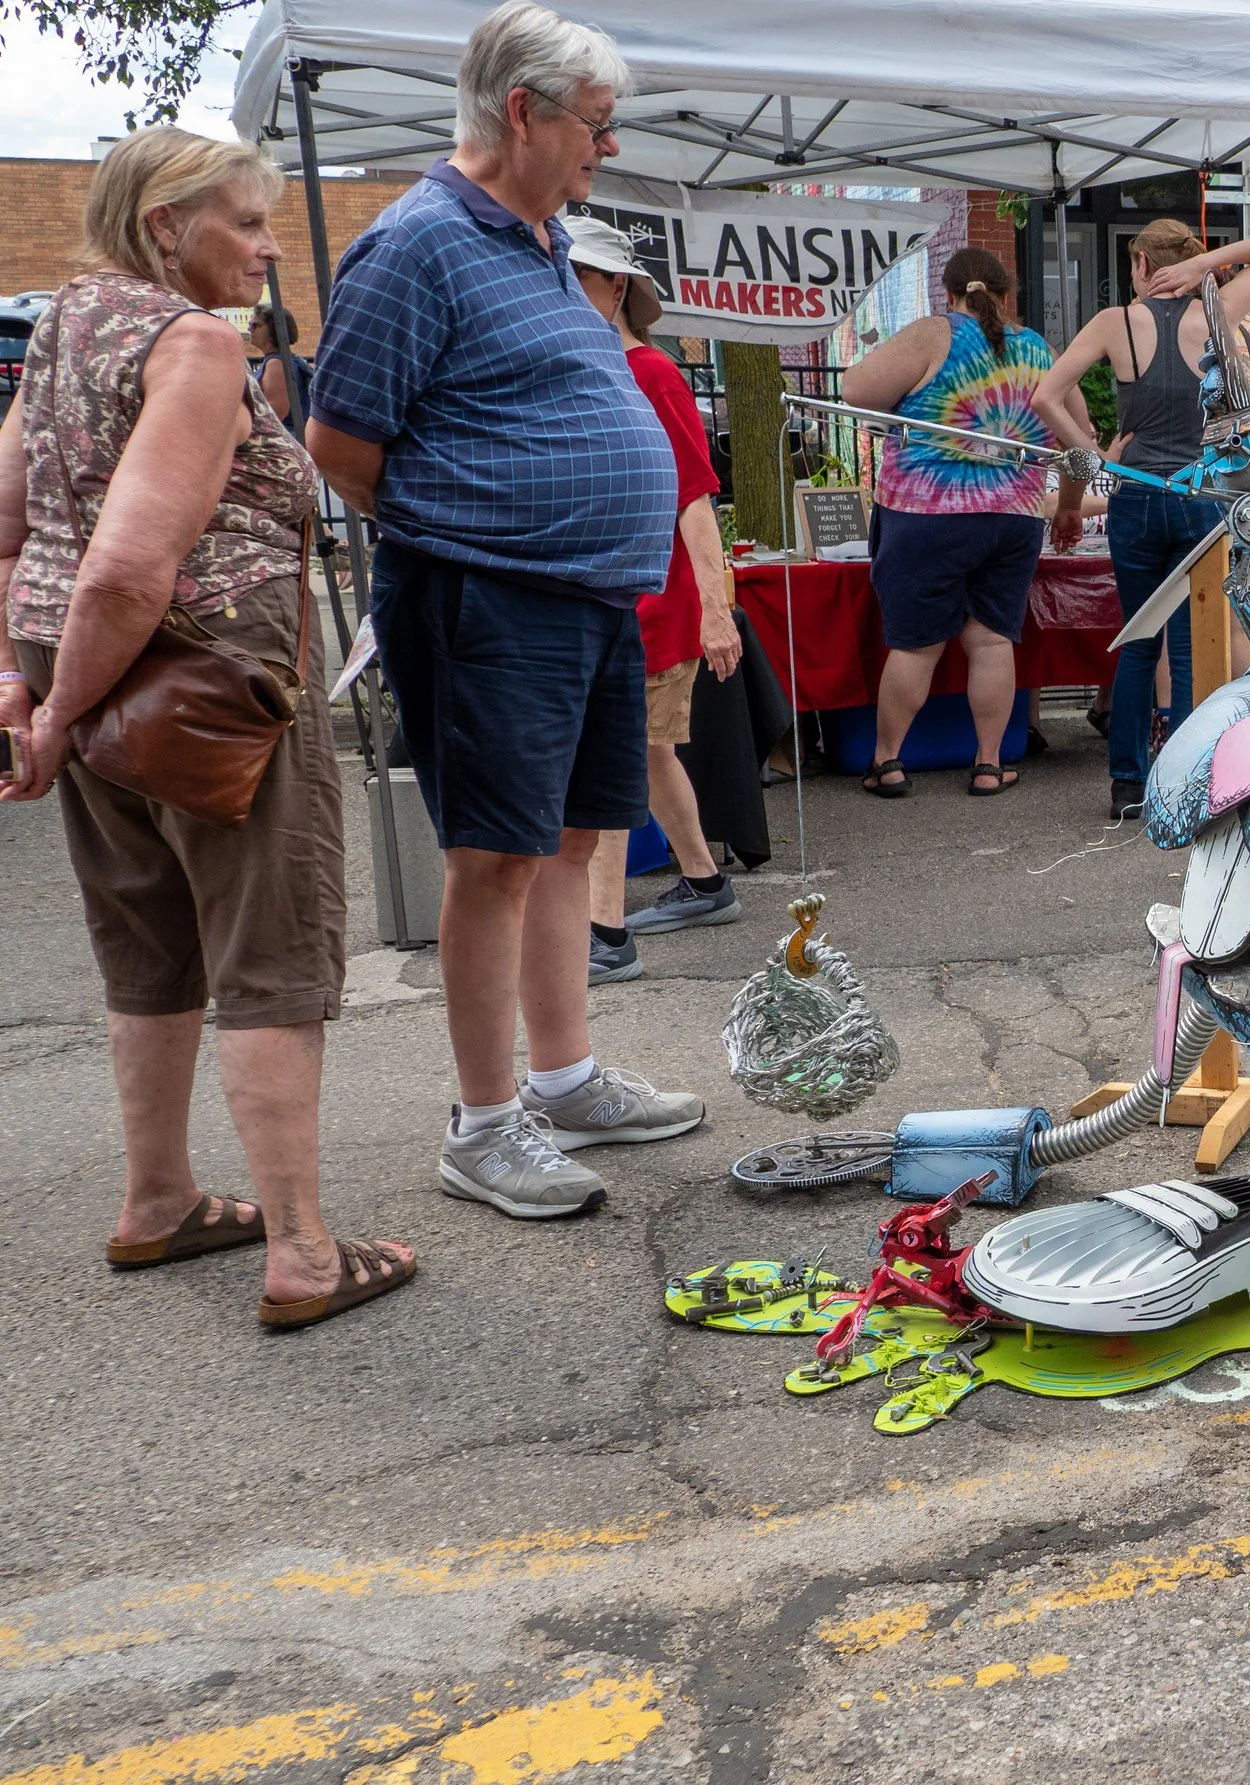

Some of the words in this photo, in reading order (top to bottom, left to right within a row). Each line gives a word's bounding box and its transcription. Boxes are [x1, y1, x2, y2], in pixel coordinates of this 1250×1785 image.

[679, 278, 826, 318] MAKERS
[830, 289, 866, 316] NE
[831, 494, 848, 502] MORE
[818, 524, 842, 532] FORGET
[849, 523, 858, 531] TO
[818, 534, 840, 542] CHECK
